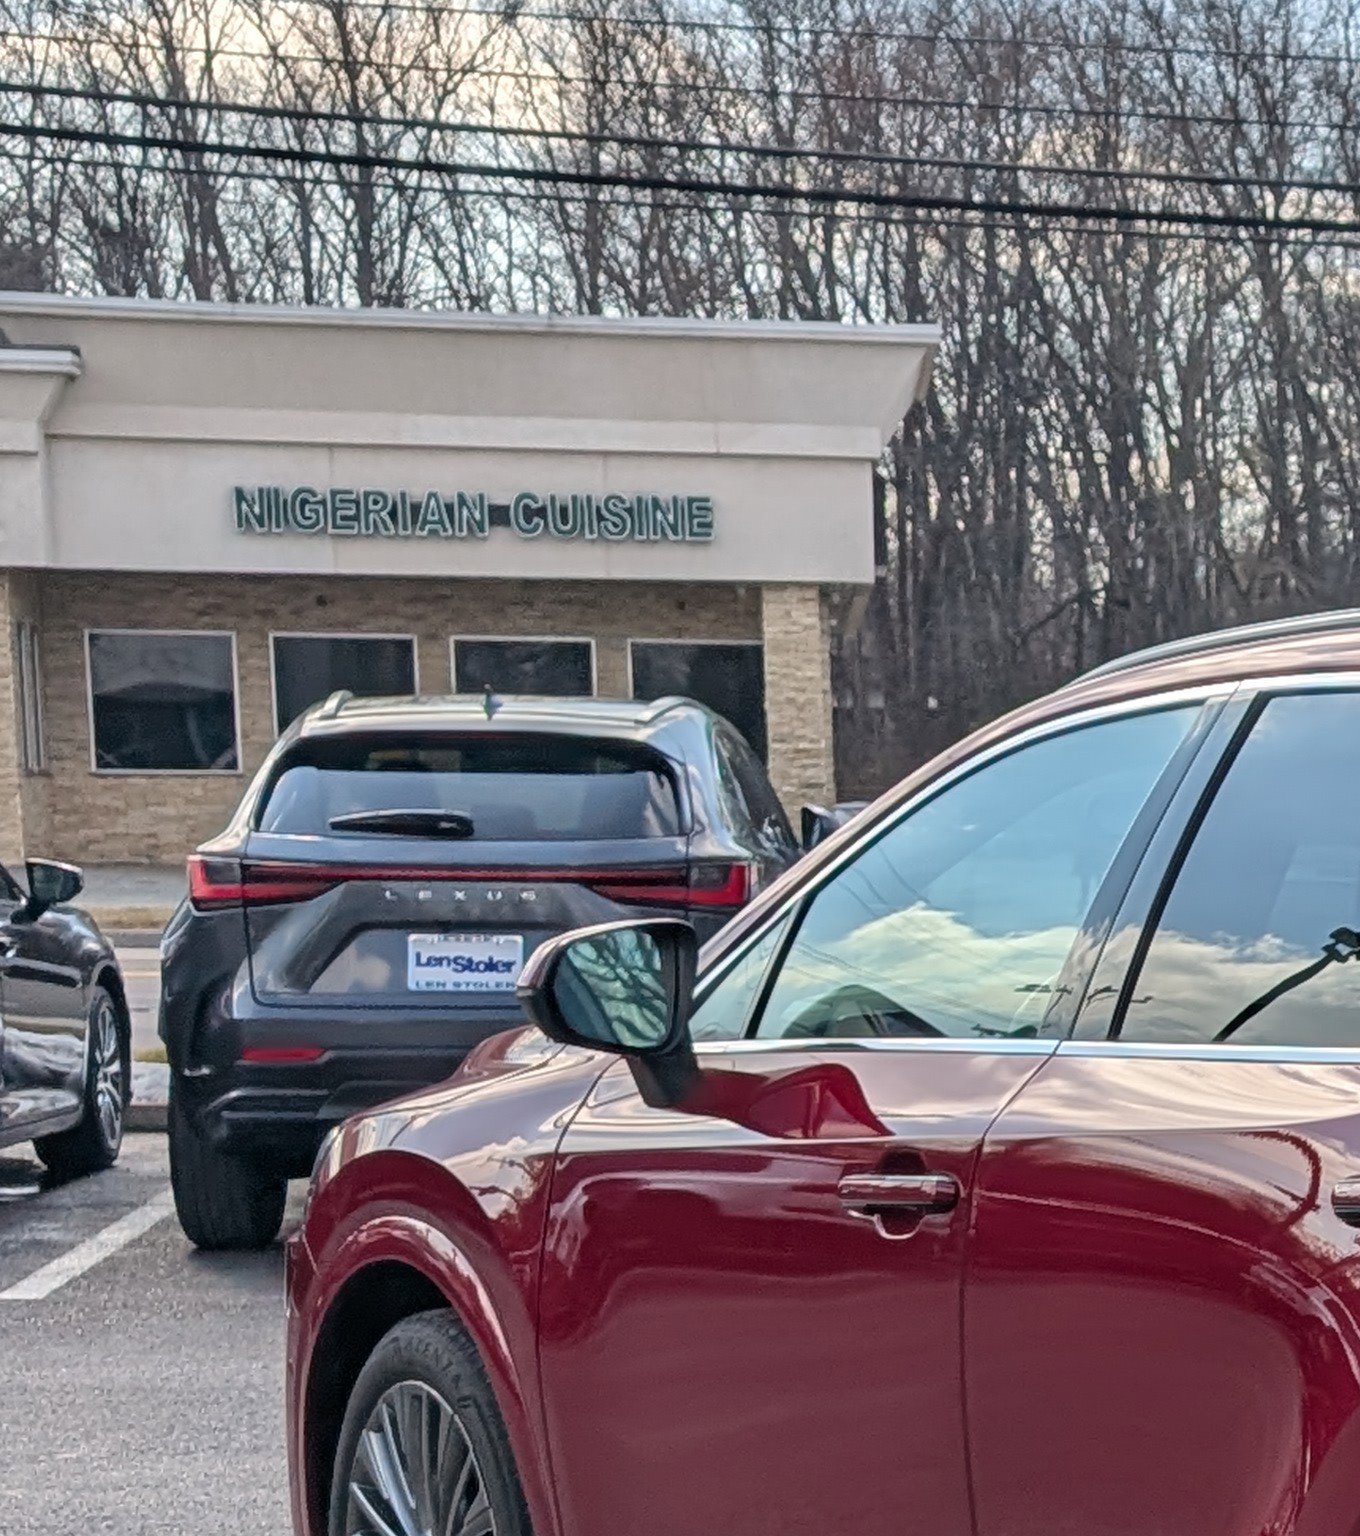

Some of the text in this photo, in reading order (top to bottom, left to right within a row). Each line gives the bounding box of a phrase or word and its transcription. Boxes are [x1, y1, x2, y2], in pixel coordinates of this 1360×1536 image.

[233, 484, 716, 542] NIGERIAN CUISINE
[384, 890, 537, 901] LEXUS
